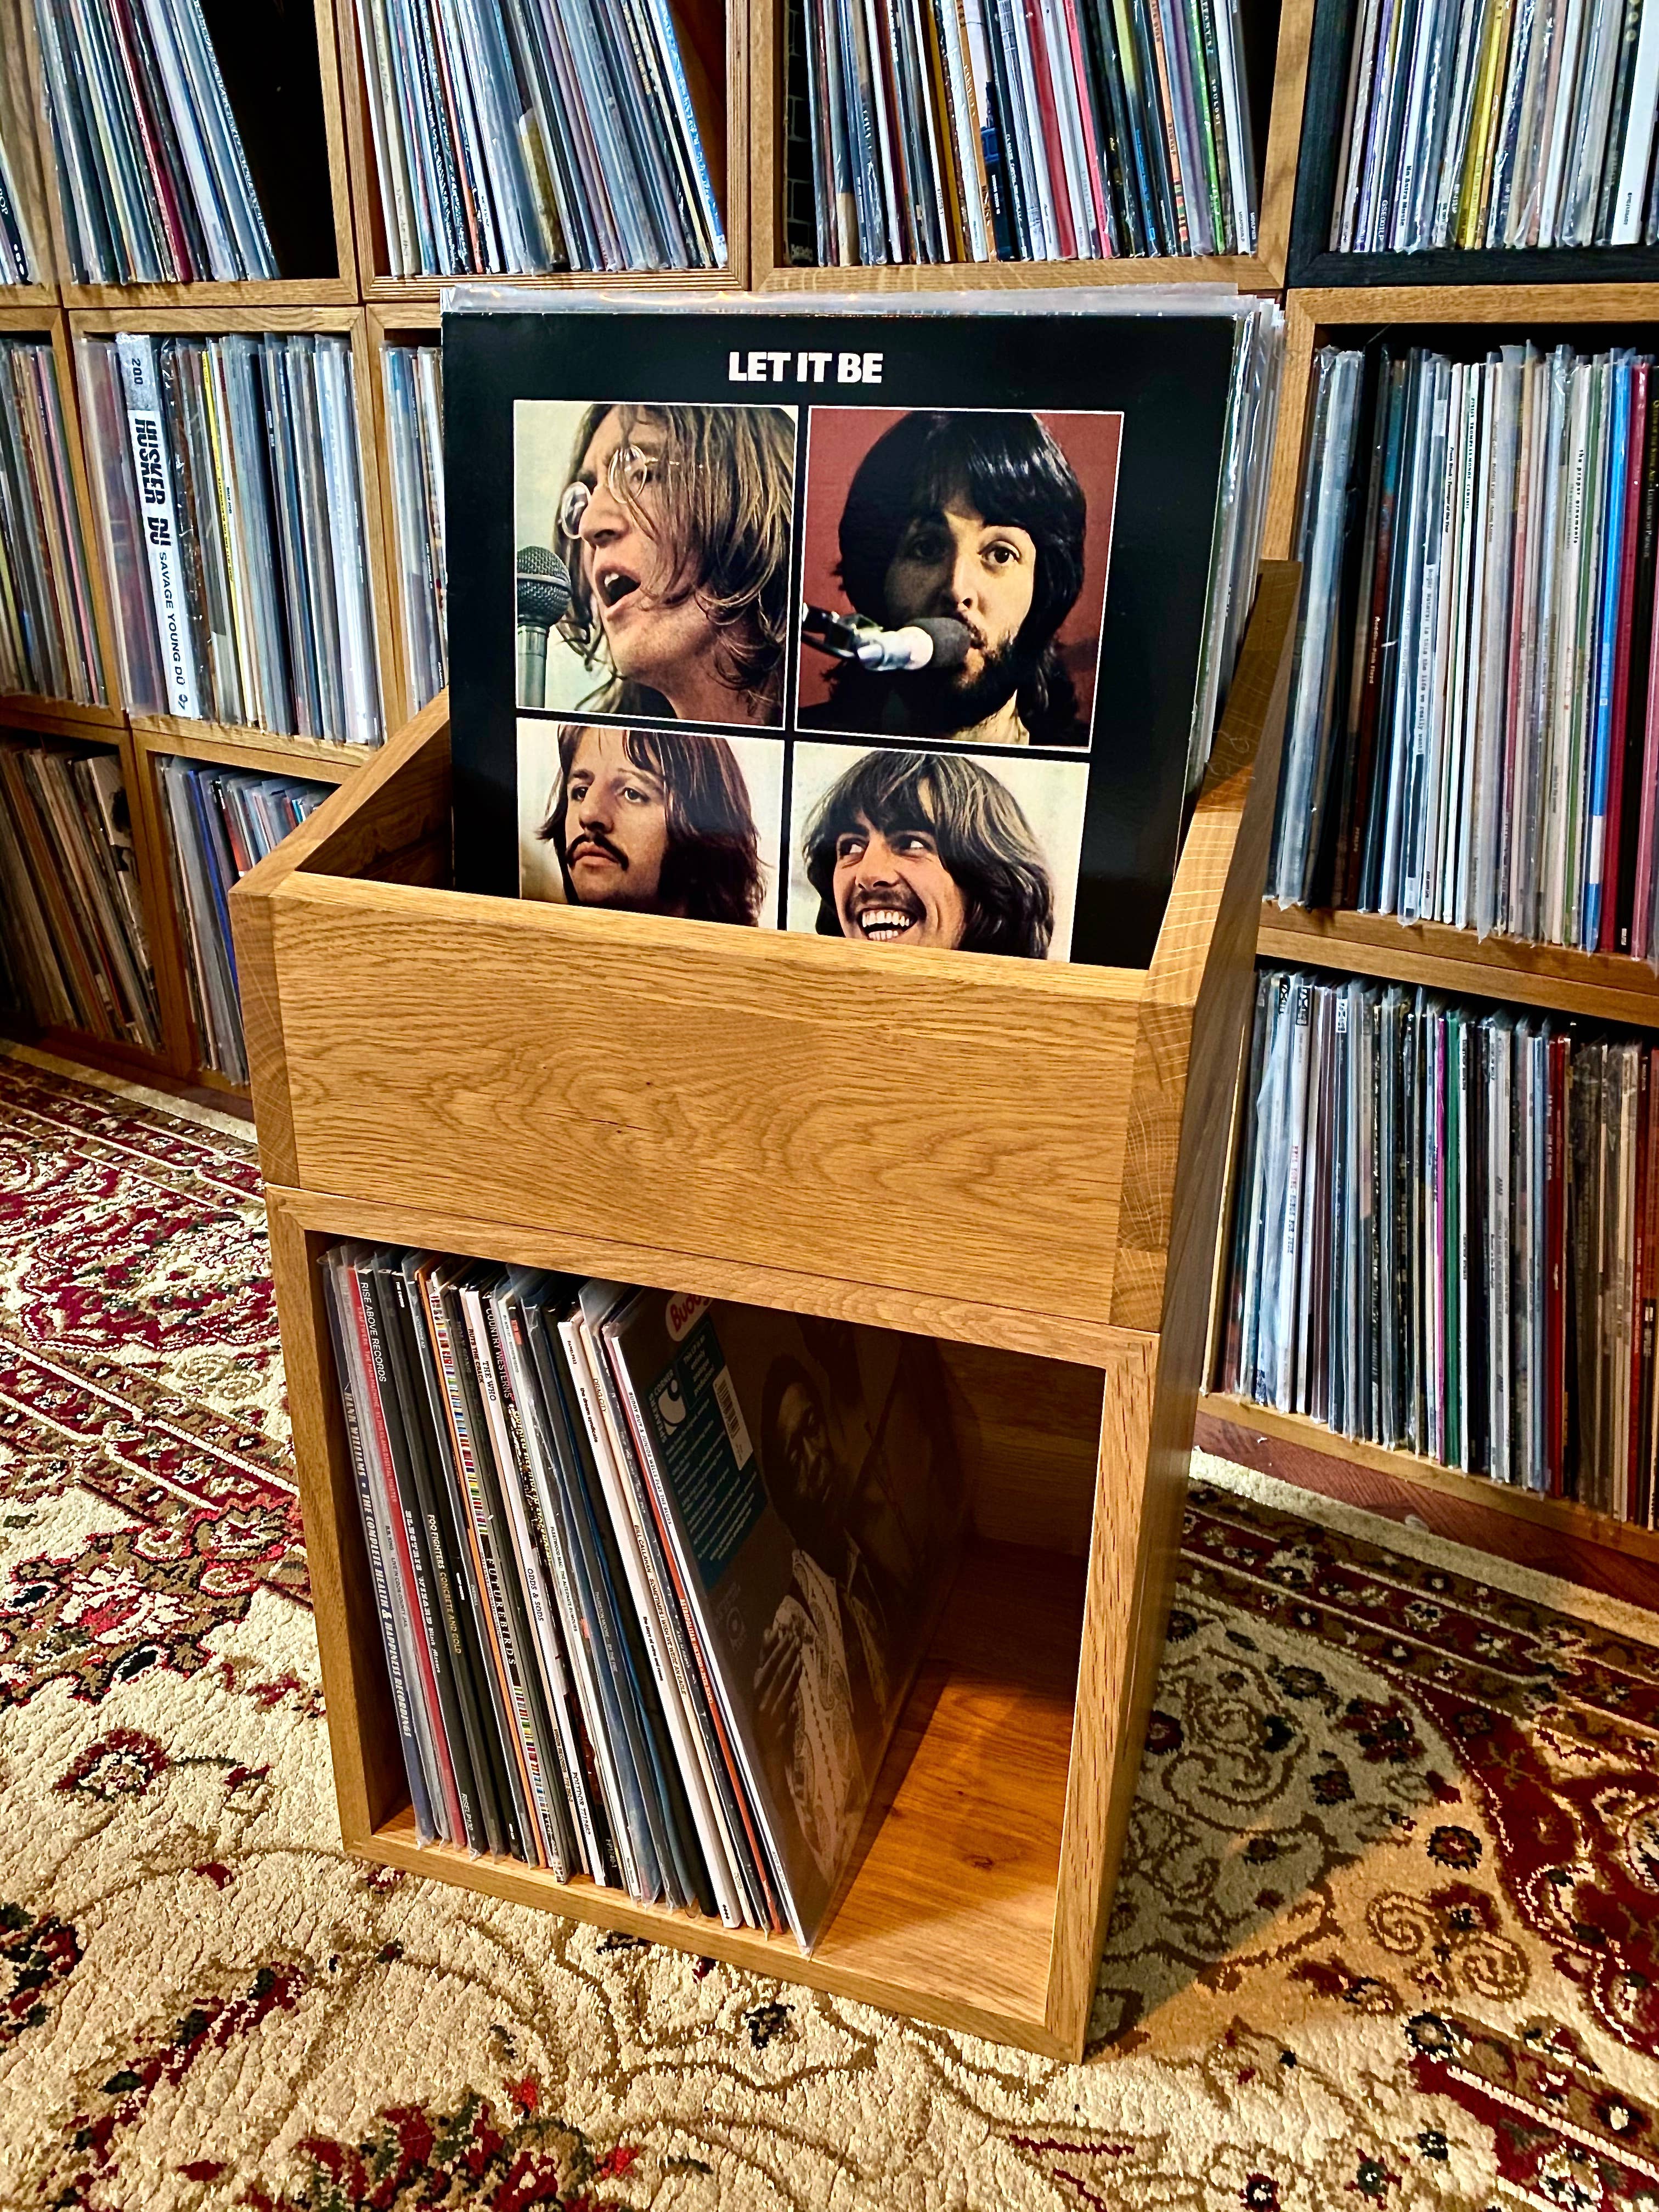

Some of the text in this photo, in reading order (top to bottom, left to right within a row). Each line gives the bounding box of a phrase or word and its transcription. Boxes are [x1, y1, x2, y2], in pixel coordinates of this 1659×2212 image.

[131, 358, 143, 385] 200
[729, 352, 883, 383] LET IT BE
[158, 551, 173, 609] SAVAGE
[167, 613, 181, 662] YOUNG
[362, 1281, 386, 1382] RISE ABOVE RECORDS
[486, 1307, 500, 1349] COUNTRY
[495, 1351, 511, 1398] WESTERNS
[370, 1378, 379, 1407] MACHINE
[476, 1361, 484, 1384] CRACK
[483, 1361, 496, 1401] THE WHO
[593, 1377, 607, 1413] DRAG CITY
[345, 1391, 365, 1476] HANK WILLIAMS
[582, 1397, 591, 1415] dream
[588, 1415, 599, 1443] syndicate
[628, 1391, 638, 1413] BUDDY
[642, 1434, 652, 1457] JUNIOR
[650, 1458, 658, 1477] WELLS
[405, 1509, 422, 1572] ELECTRIC
[417, 1576, 432, 1625] WIZARD
[428, 1513, 462, 1654] FOO FIGHTERS CONCRETE AND GOLD
[550, 1526, 560, 1556] FLEETWOOD
[562, 1580, 571, 1606] ALTERNATE
[568, 1606, 578, 1632] RUMOURS
[361, 1493, 411, 1738] THE COMPLETE HEALTH & HAPPINESS RECORDINGS
[398, 1593, 407, 1616] COUNTY
[487, 1557, 516, 1664] FUTUREBIRDS
[527, 1567, 537, 1590] ODDS
[534, 1600, 545, 1622] SODS
[595, 1591, 604, 1618] THURSTON
[639, 1539, 651, 1573] CALLAHAN
[650, 1577, 663, 1615] SOMETIMES
[665, 1636, 672, 1645] WE
[669, 1646, 677, 1665] WERE
[674, 1665, 680, 1675] AN
[677, 1675, 686, 1696] EAGLE
[680, 1598, 695, 1641] RETROPOLITAN
[558, 1747, 567, 1773] RECORDS
[572, 1771, 584, 1805] POLYDOR
